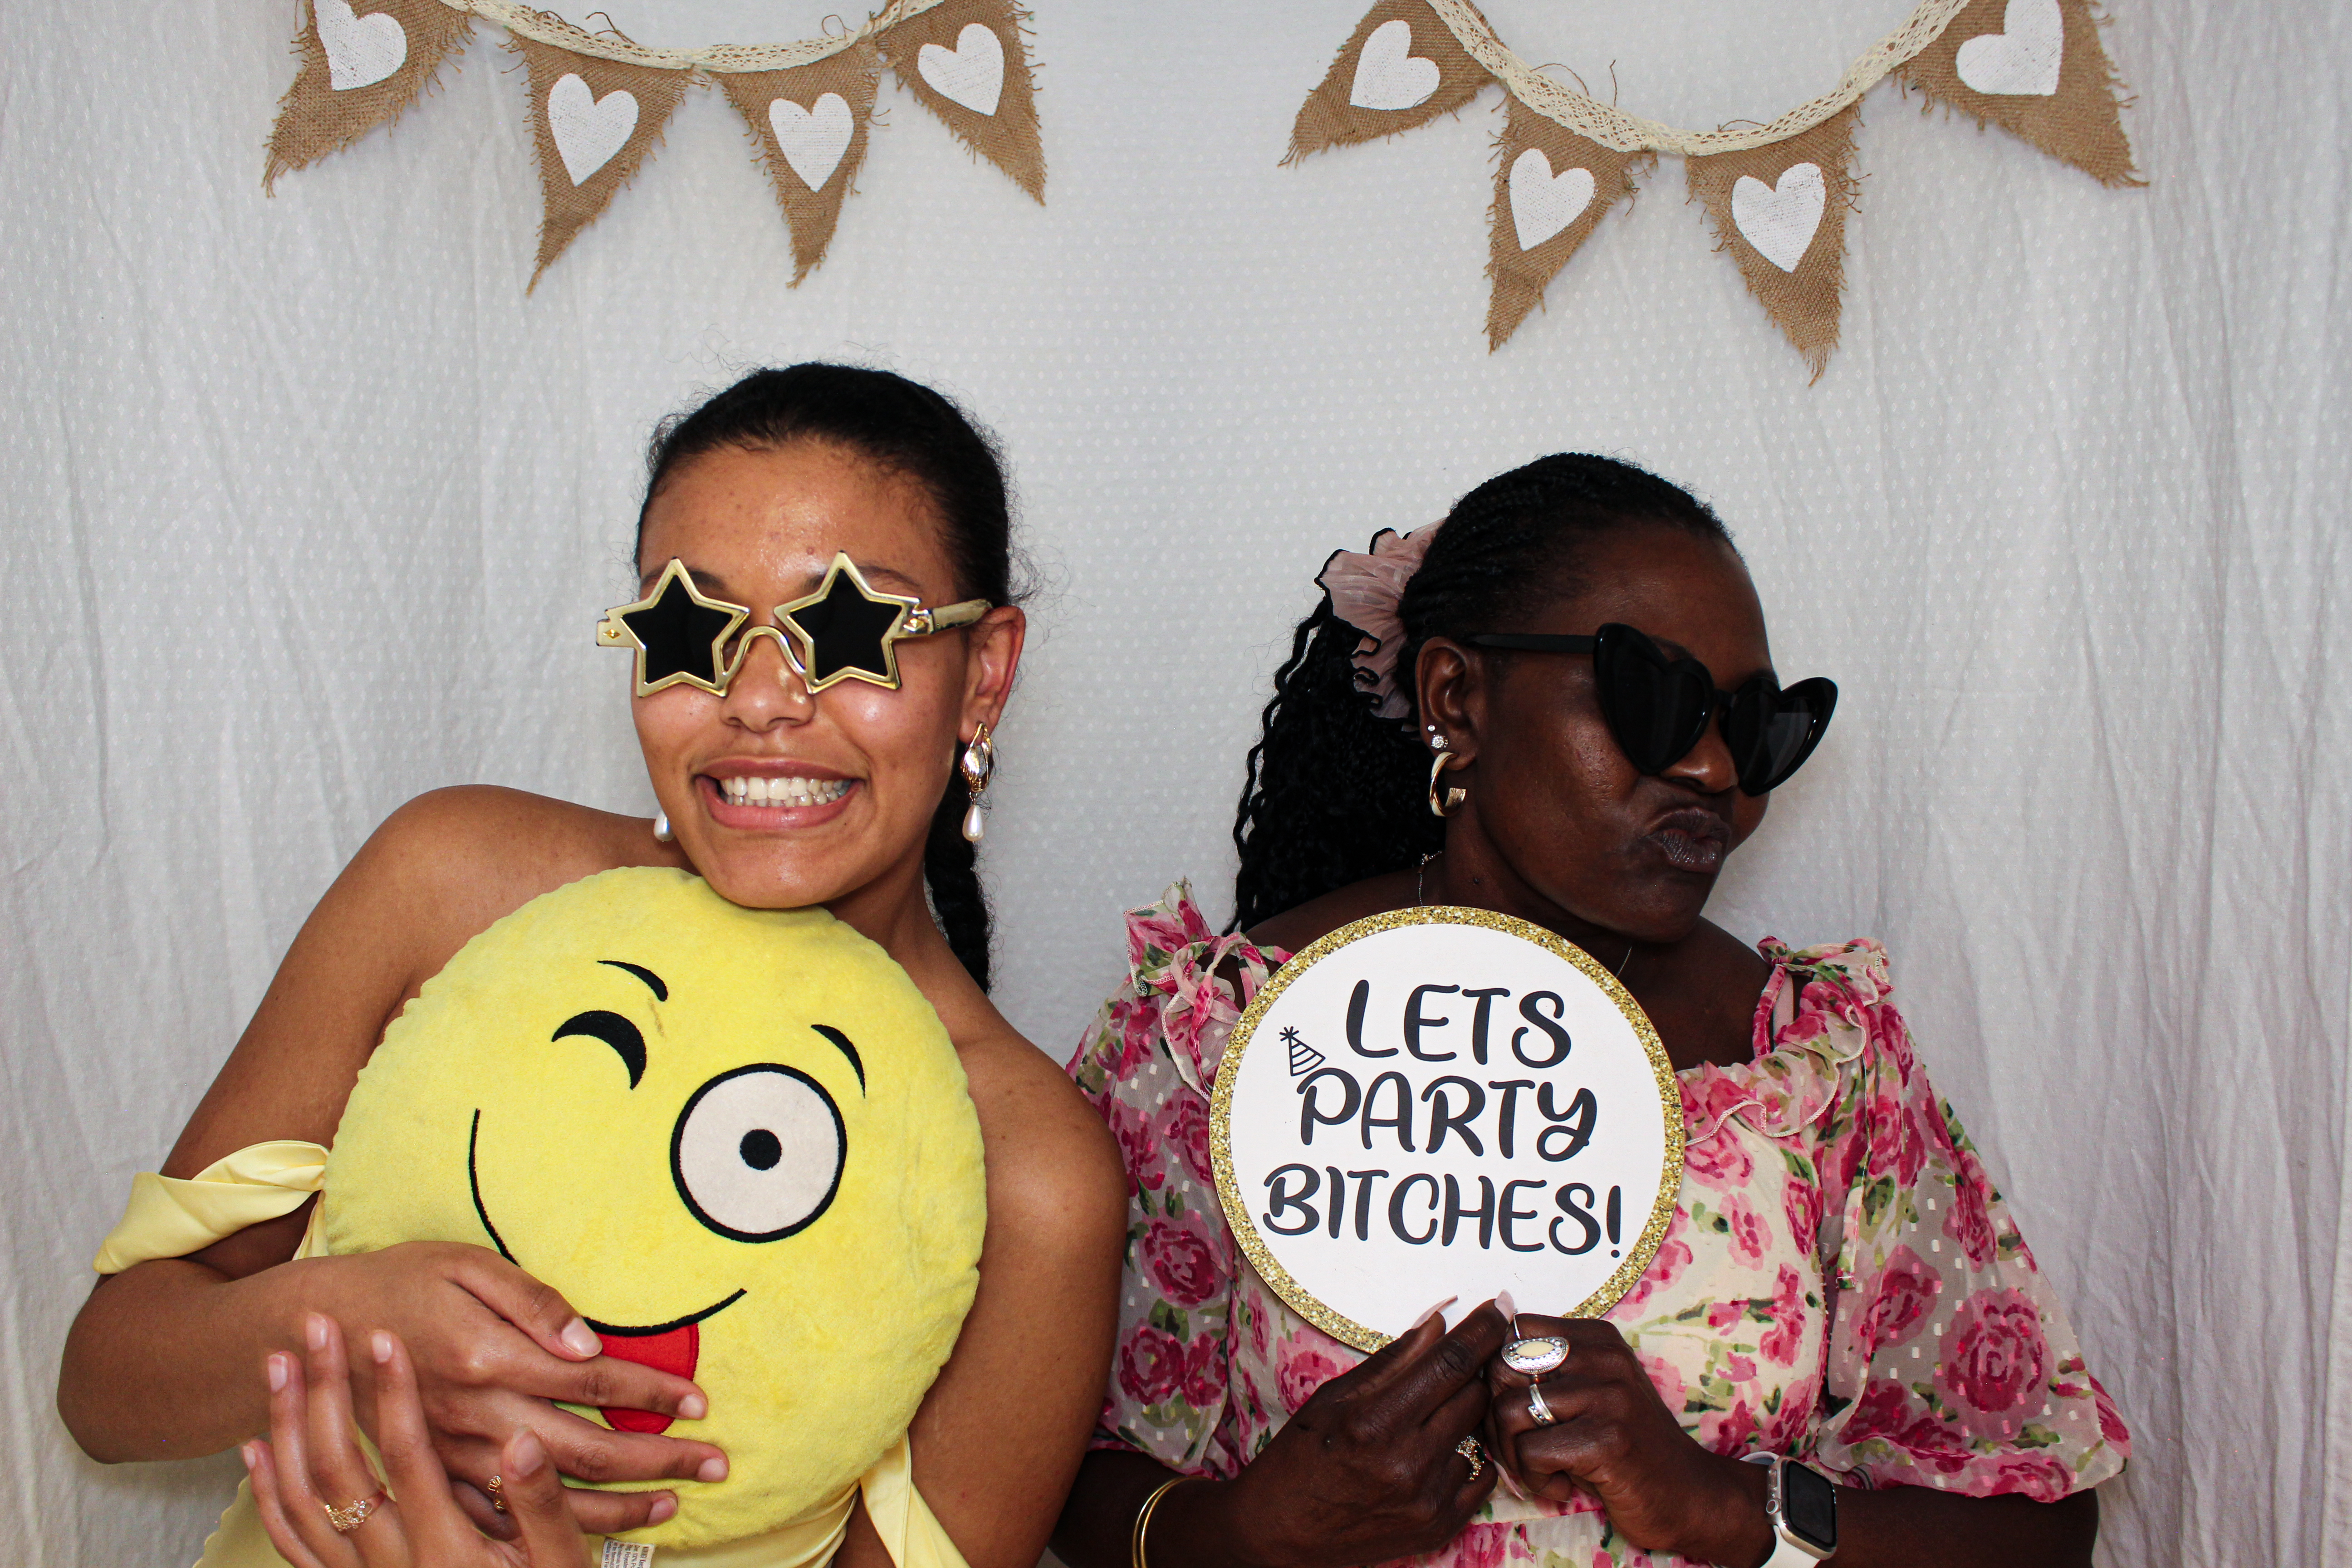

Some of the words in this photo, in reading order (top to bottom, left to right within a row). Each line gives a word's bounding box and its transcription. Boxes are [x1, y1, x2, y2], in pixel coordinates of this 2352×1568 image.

[1346, 979, 1572, 1069] LETS
[1296, 1067, 1597, 1162] PARTY
[1262, 1163, 1622, 1258] BITCHES!
